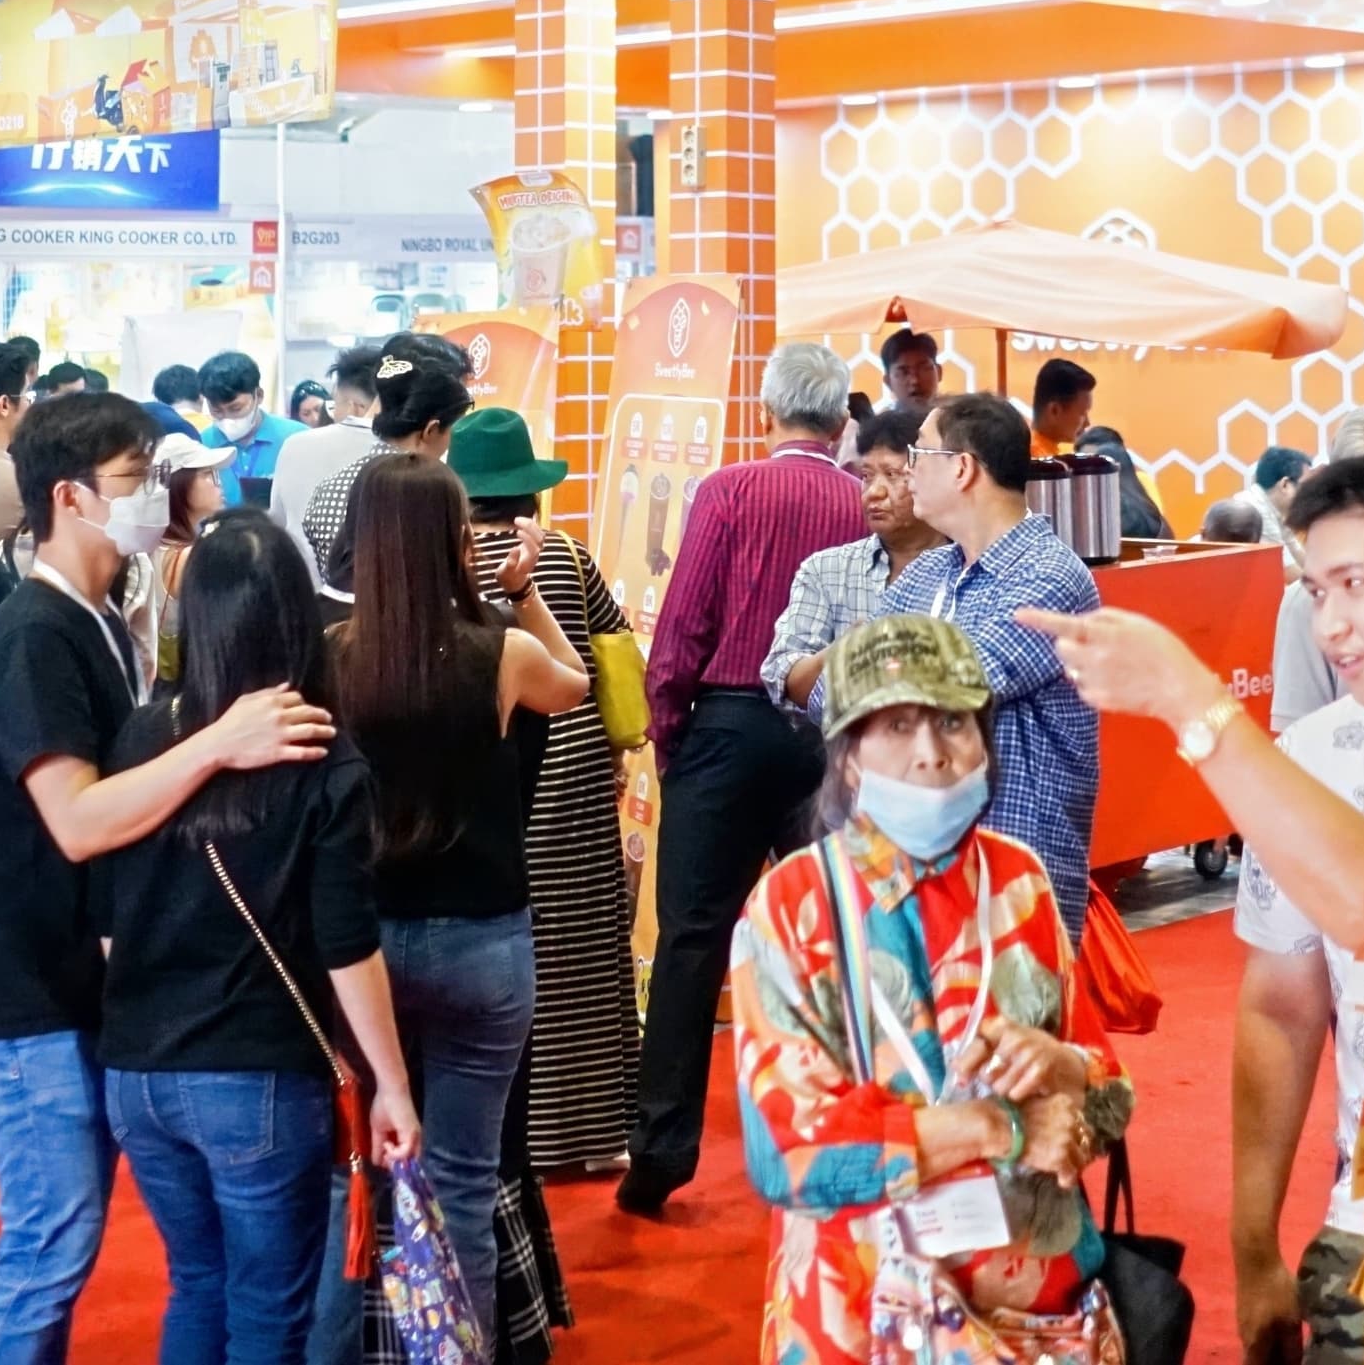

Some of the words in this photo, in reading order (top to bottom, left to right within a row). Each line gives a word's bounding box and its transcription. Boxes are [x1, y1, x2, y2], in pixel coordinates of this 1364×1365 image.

[11, 229, 75, 244] COOKER
[80, 229, 114, 243] KING
[118, 231, 178, 244] COOKER
[444, 238, 479, 252] ROYAL
[1228, 668, 1273, 700] Bee
